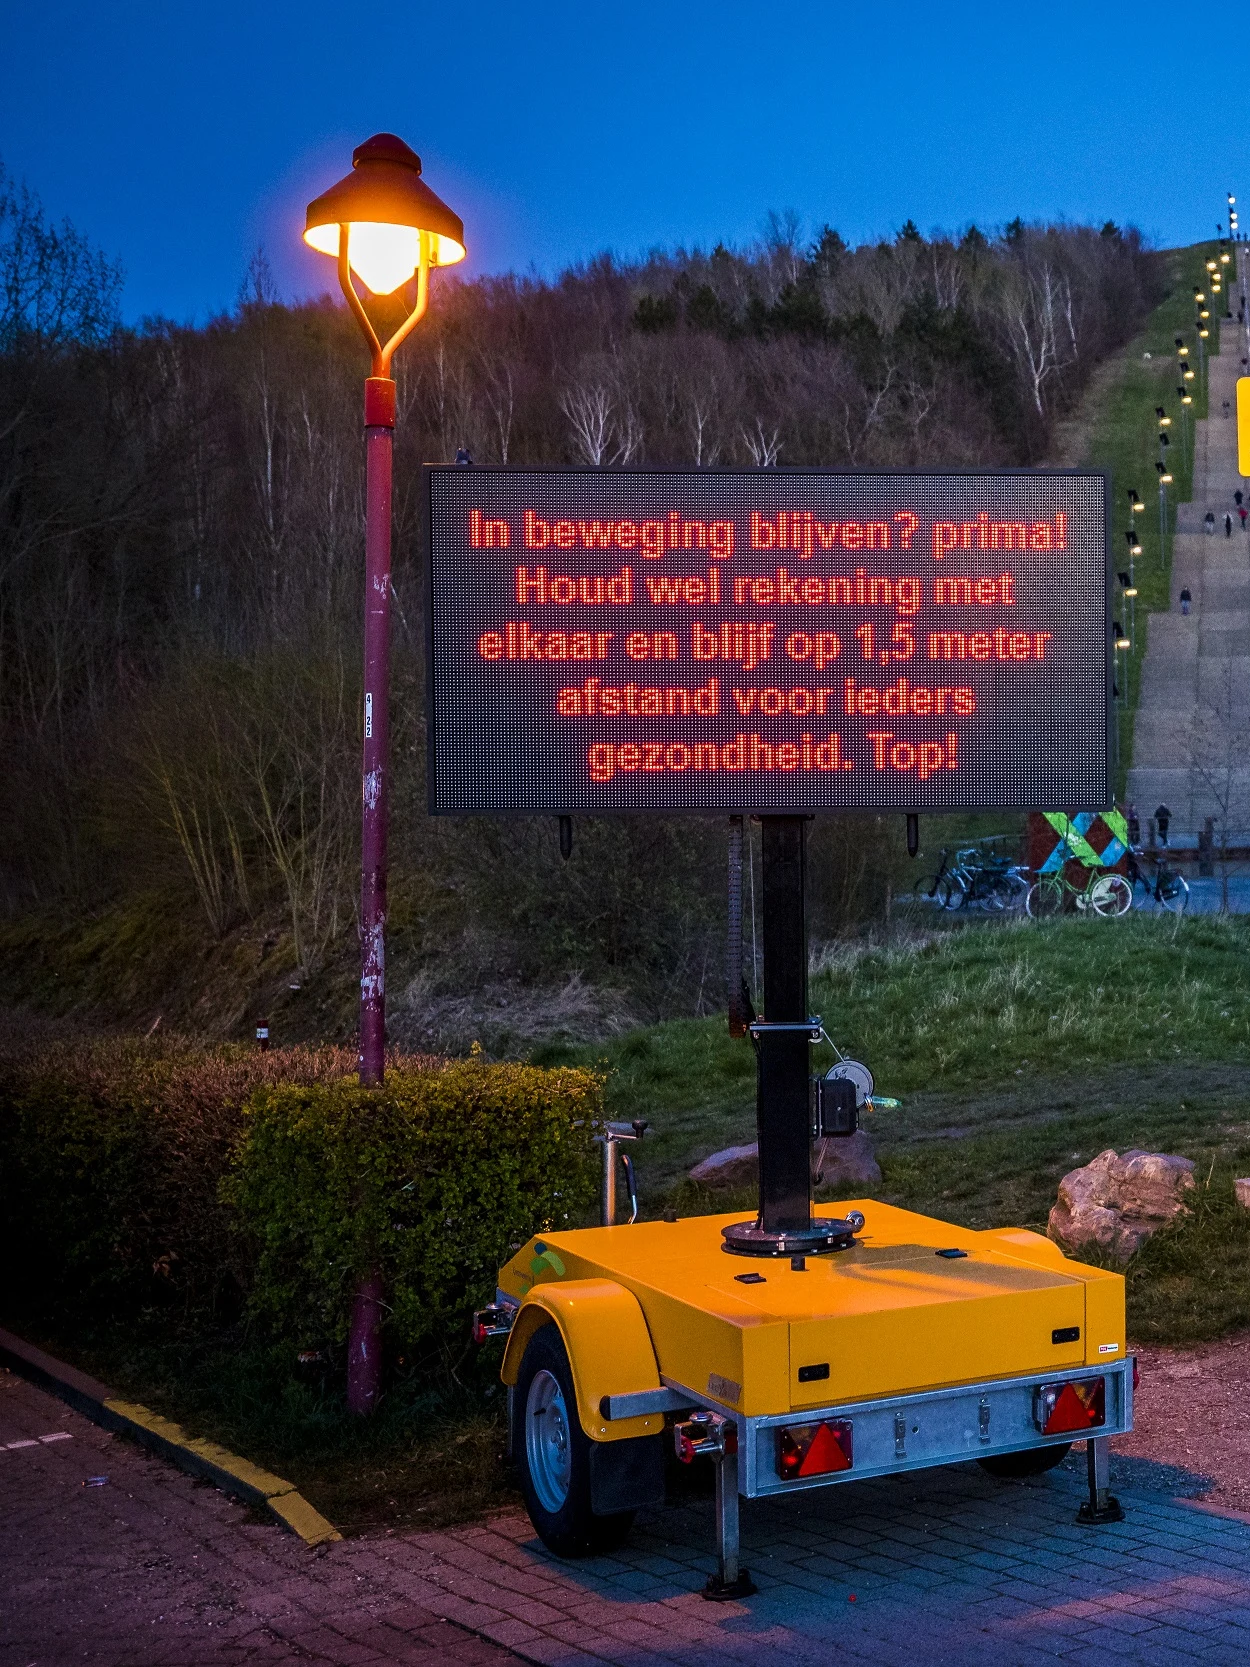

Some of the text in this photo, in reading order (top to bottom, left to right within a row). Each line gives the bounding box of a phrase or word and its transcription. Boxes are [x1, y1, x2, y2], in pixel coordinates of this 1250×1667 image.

[470, 510, 1067, 560] In beweging blijven? prima!
[515, 567, 1015, 615] Houd wel rekening met
[479, 621, 1052, 670] elkaar en blijf op 1,5 meter
[366, 694, 371, 704] 4
[556, 679, 976, 717] afstand voor ieders
[588, 732, 958, 781] gezondheid. Top!
